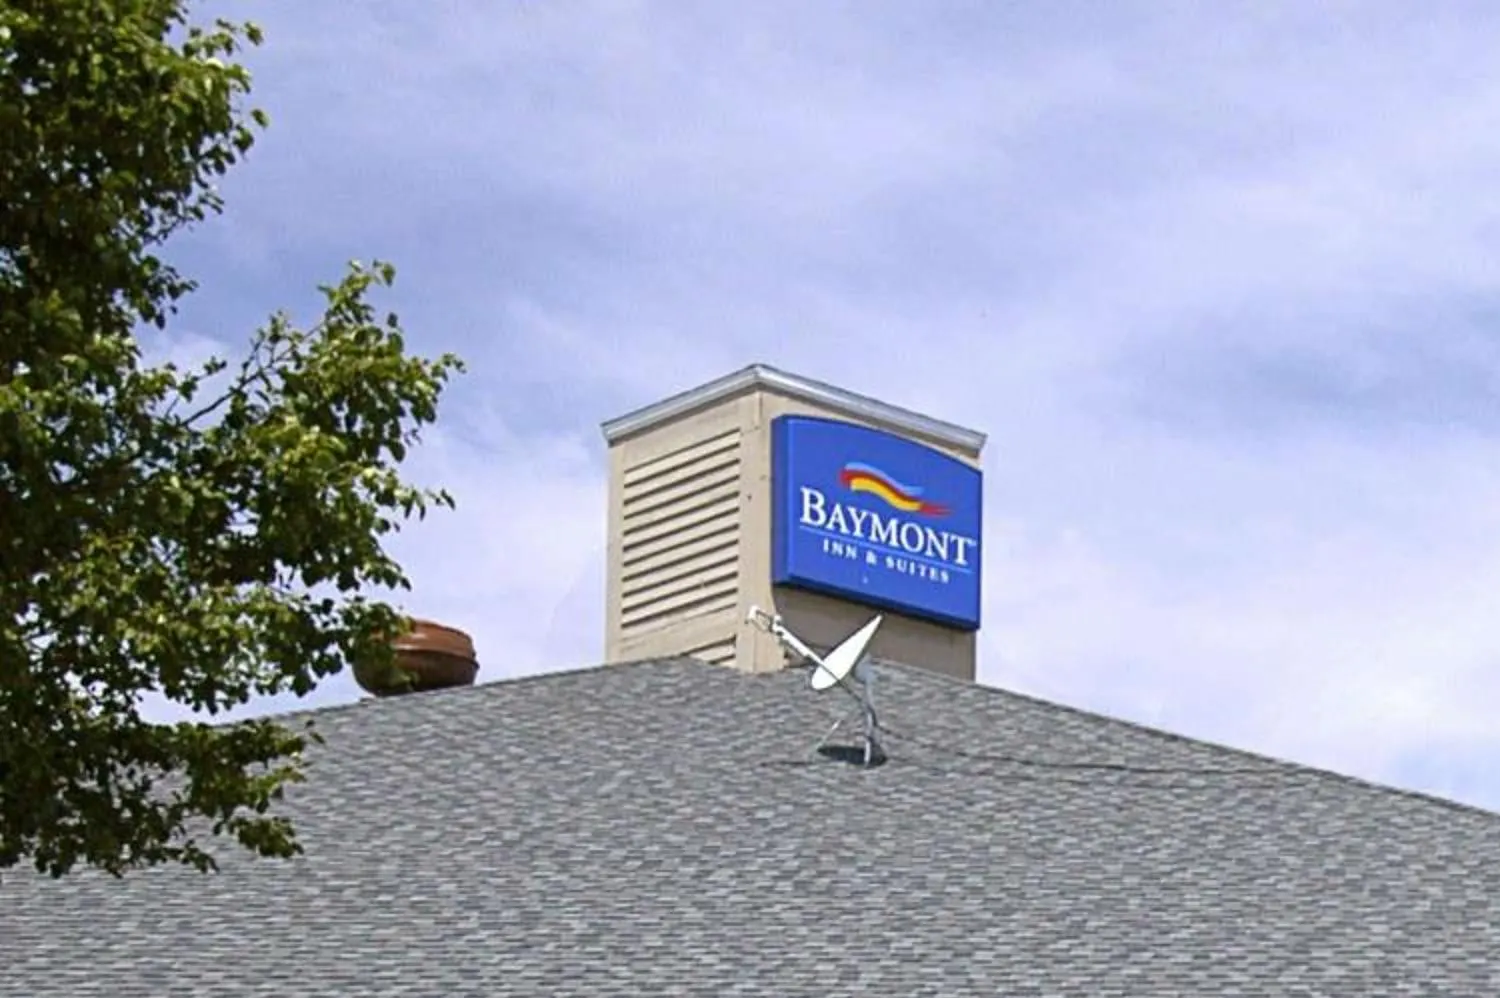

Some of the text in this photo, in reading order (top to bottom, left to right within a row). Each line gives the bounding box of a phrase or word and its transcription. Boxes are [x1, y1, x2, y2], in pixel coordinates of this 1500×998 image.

[800, 487, 975, 565] BAYMONT
[822, 538, 949, 584] INN & SUITES
